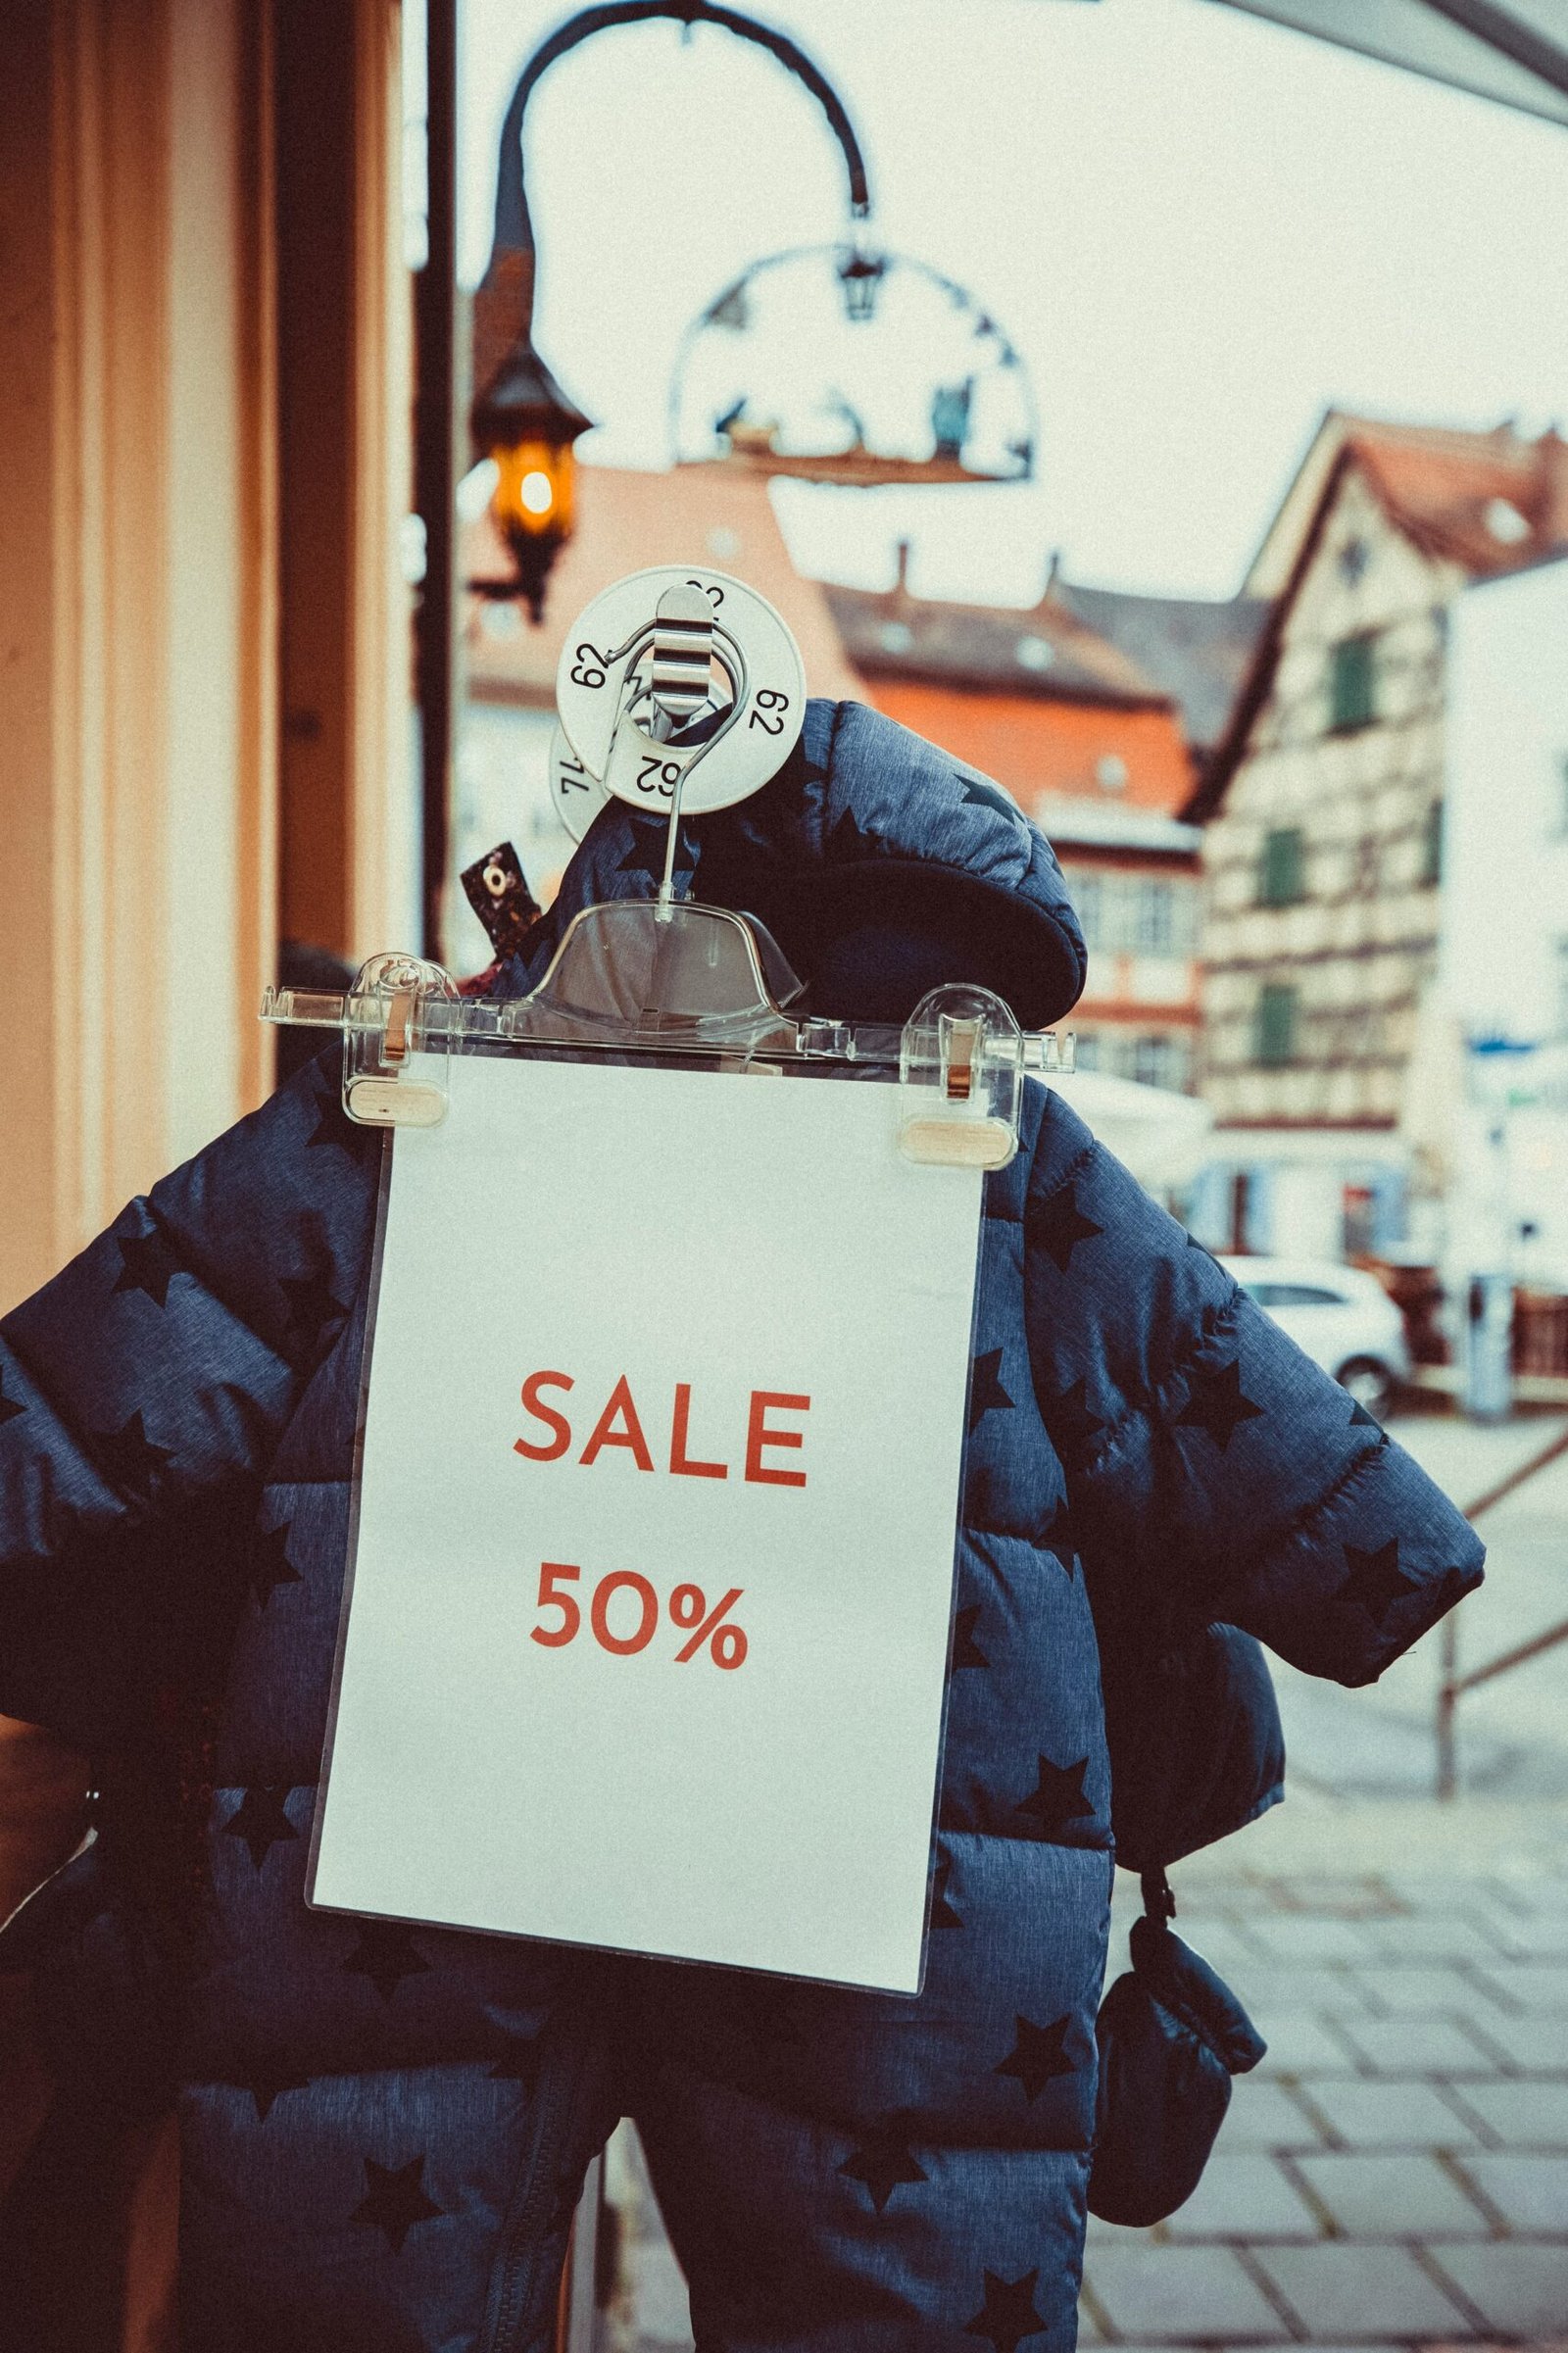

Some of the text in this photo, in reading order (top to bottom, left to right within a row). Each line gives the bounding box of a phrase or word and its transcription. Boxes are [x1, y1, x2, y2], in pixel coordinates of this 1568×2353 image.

[570, 643, 613, 689] 62
[749, 689, 790, 736] 62
[637, 756, 682, 797] 62
[514, 1370, 810, 1488] SALE
[530, 1562, 748, 1670] 50%
